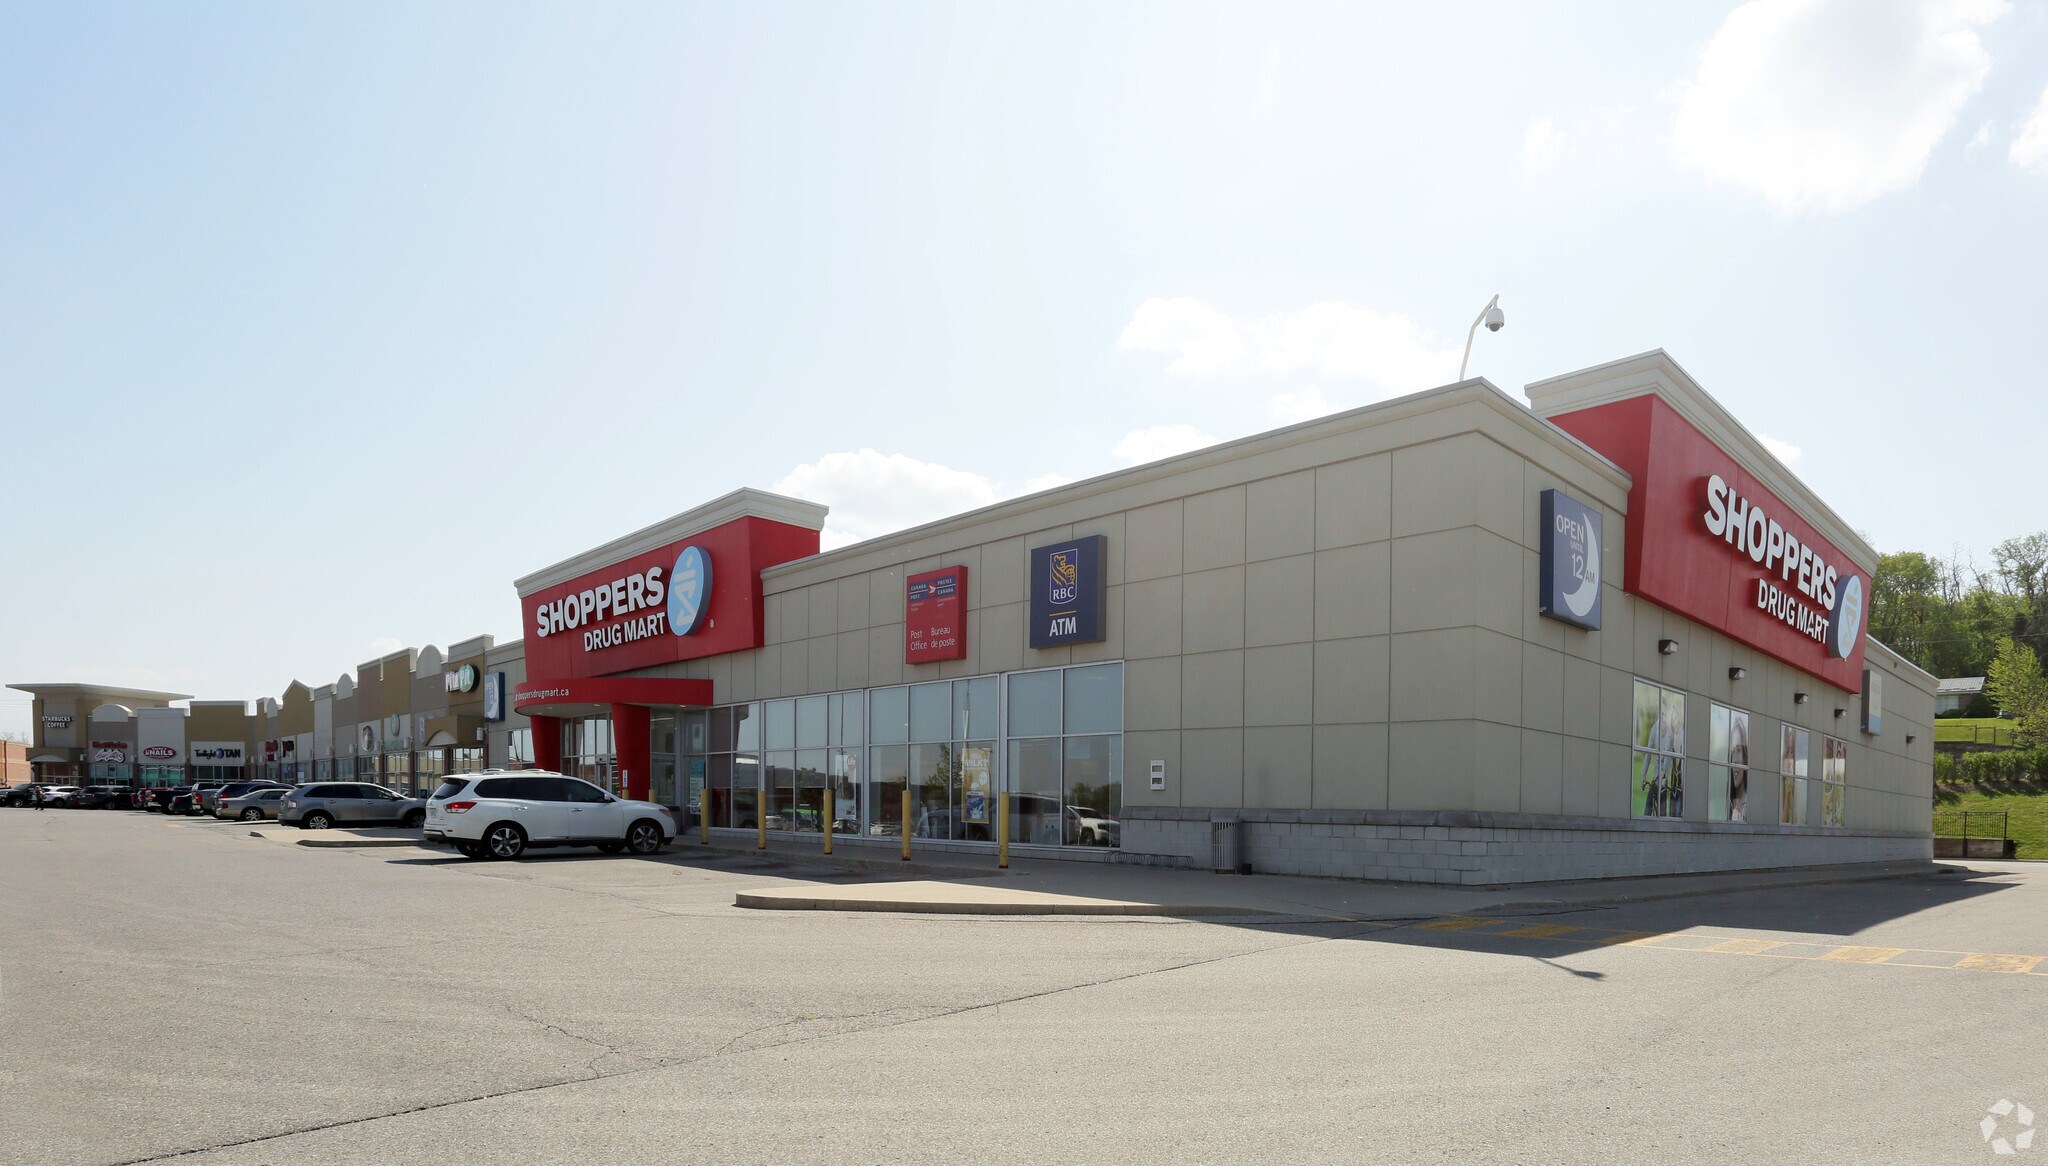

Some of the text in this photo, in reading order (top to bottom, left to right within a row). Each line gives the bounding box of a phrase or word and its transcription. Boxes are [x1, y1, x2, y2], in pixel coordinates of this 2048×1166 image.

[1556, 514, 1584, 543] OPEN
[1570, 540, 1584, 554] UNTIL
[1704, 475, 1838, 611] SHOPPERS
[1572, 553, 1595, 584] 12 AM
[937, 587, 954, 595] CANADA
[1053, 586, 1075, 600] RBC
[537, 566, 665, 638] SHOPPERS
[1757, 578, 1829, 644] DRUG MART
[584, 612, 665, 652] DRUG MART
[930, 627, 951, 637] Bureau
[1049, 617, 1077, 637] ATM
[910, 629, 923, 640] Post
[910, 640, 928, 651] Office
[930, 637, 955, 649] de poste
[224, 749, 241, 758] TAN
